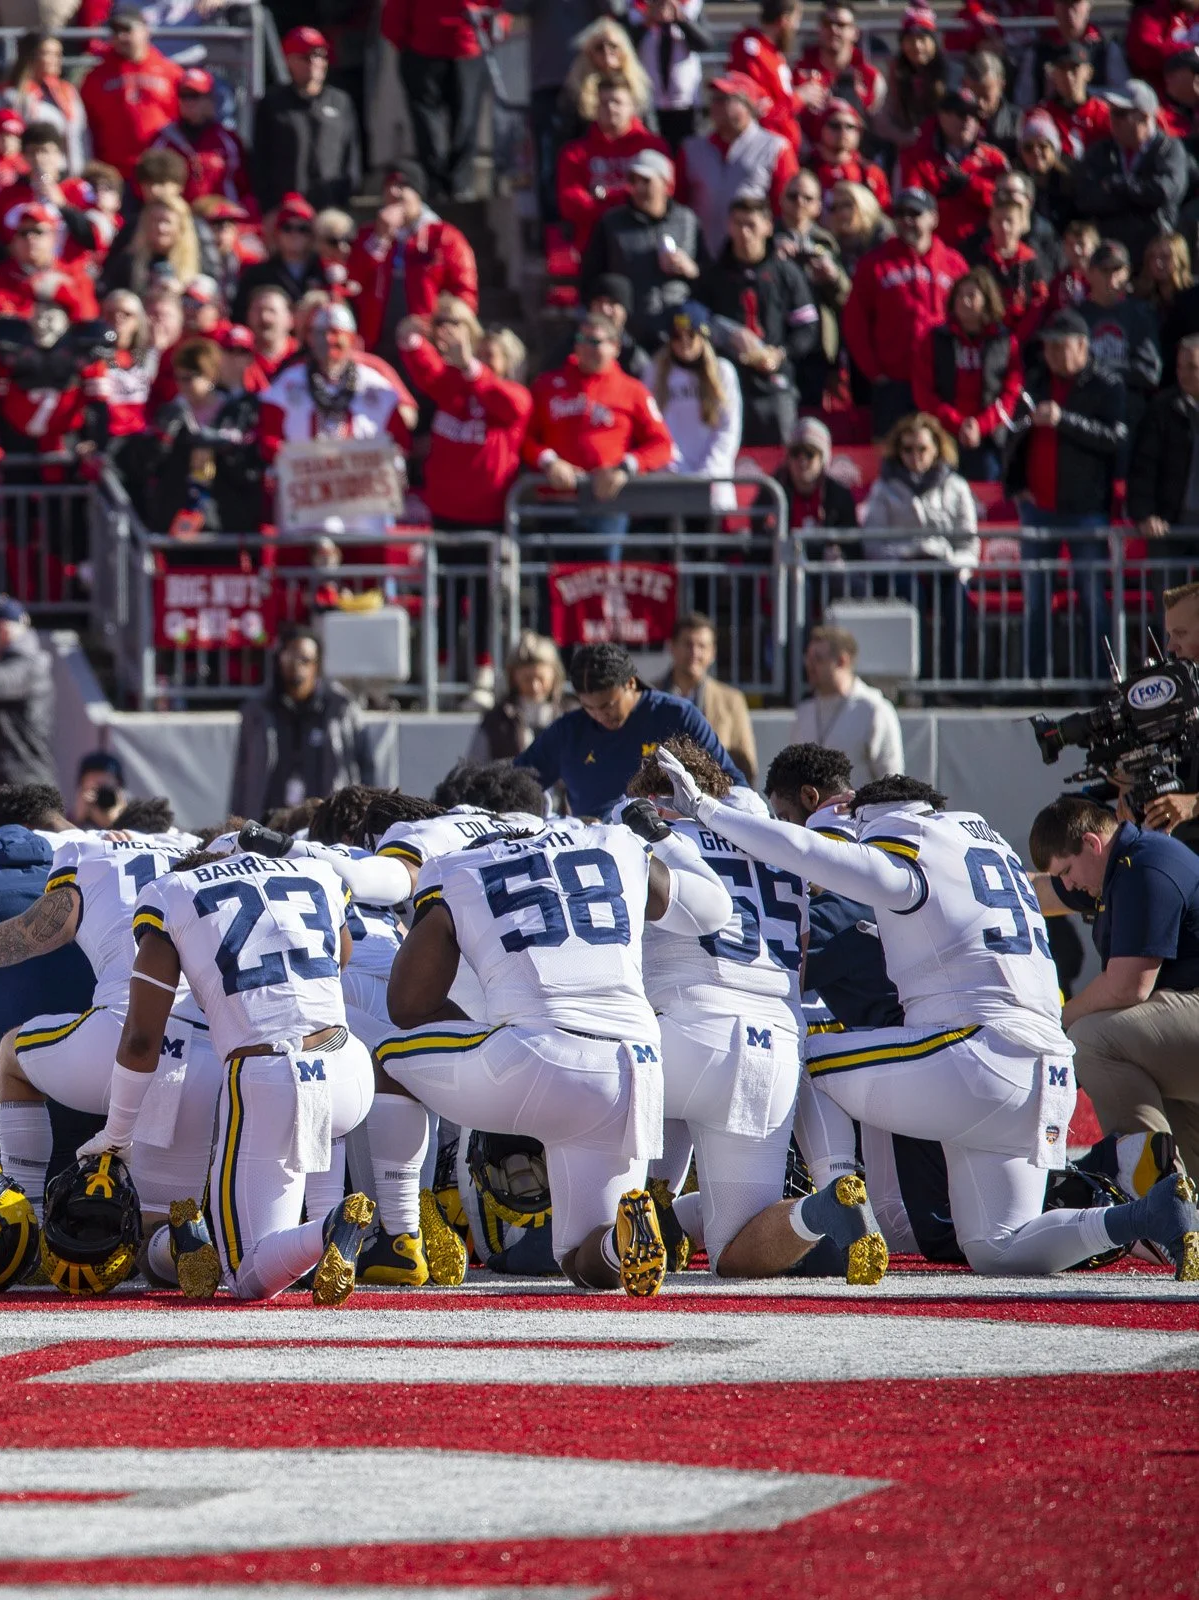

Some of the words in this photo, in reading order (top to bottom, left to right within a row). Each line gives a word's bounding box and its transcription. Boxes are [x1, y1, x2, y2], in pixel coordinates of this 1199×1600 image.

[25, 387, 59, 437] 7
[1137, 681, 1163, 699] FOX
[193, 856, 298, 883] BARRETT
[479, 848, 631, 953] 58
[698, 855, 802, 971] 55
[964, 847, 1052, 960] 99
[193, 876, 339, 996] 23
[161, 1036, 185, 1059] M
[746, 1026, 772, 1050] M
[632, 1044, 658, 1063] M
[296, 1059, 326, 1082] M
[1048, 1065, 1068, 1087] M
